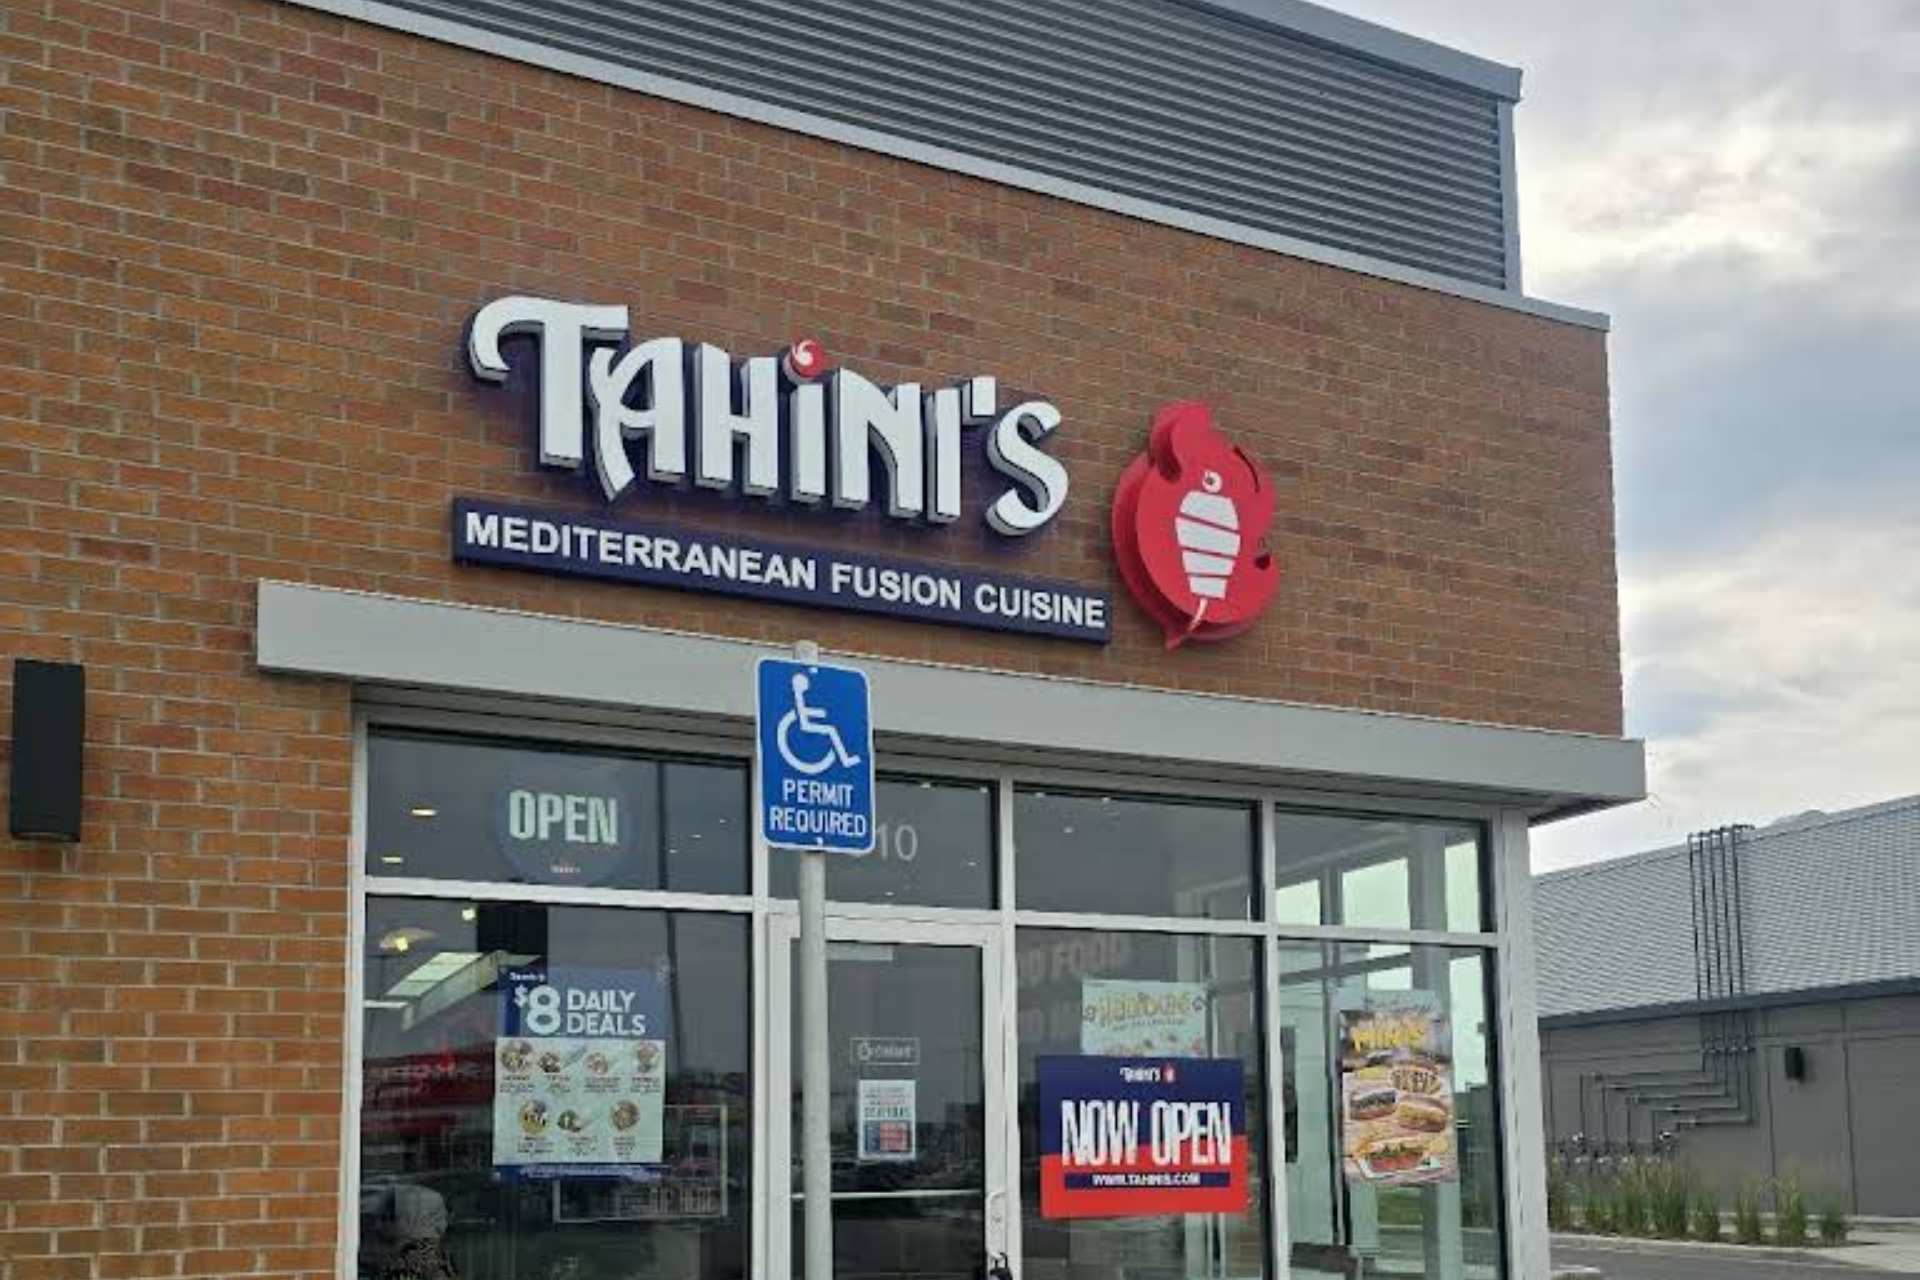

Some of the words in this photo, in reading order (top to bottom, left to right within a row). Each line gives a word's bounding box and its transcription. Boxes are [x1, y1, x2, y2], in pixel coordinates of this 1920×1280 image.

[465, 511, 817, 591] MEDITERRANEAN
[831, 562, 962, 611] FUSION
[974, 583, 1107, 629] CUISINE
[782, 779, 854, 807] PERMIT
[509, 790, 618, 845] OPEN
[769, 806, 867, 837] REQUIRED
[567, 989, 635, 1013] DAILY
[567, 1012, 646, 1036] DEALS
[1061, 1100, 1139, 1166] NOW
[1151, 1101, 1232, 1166] OPEN
